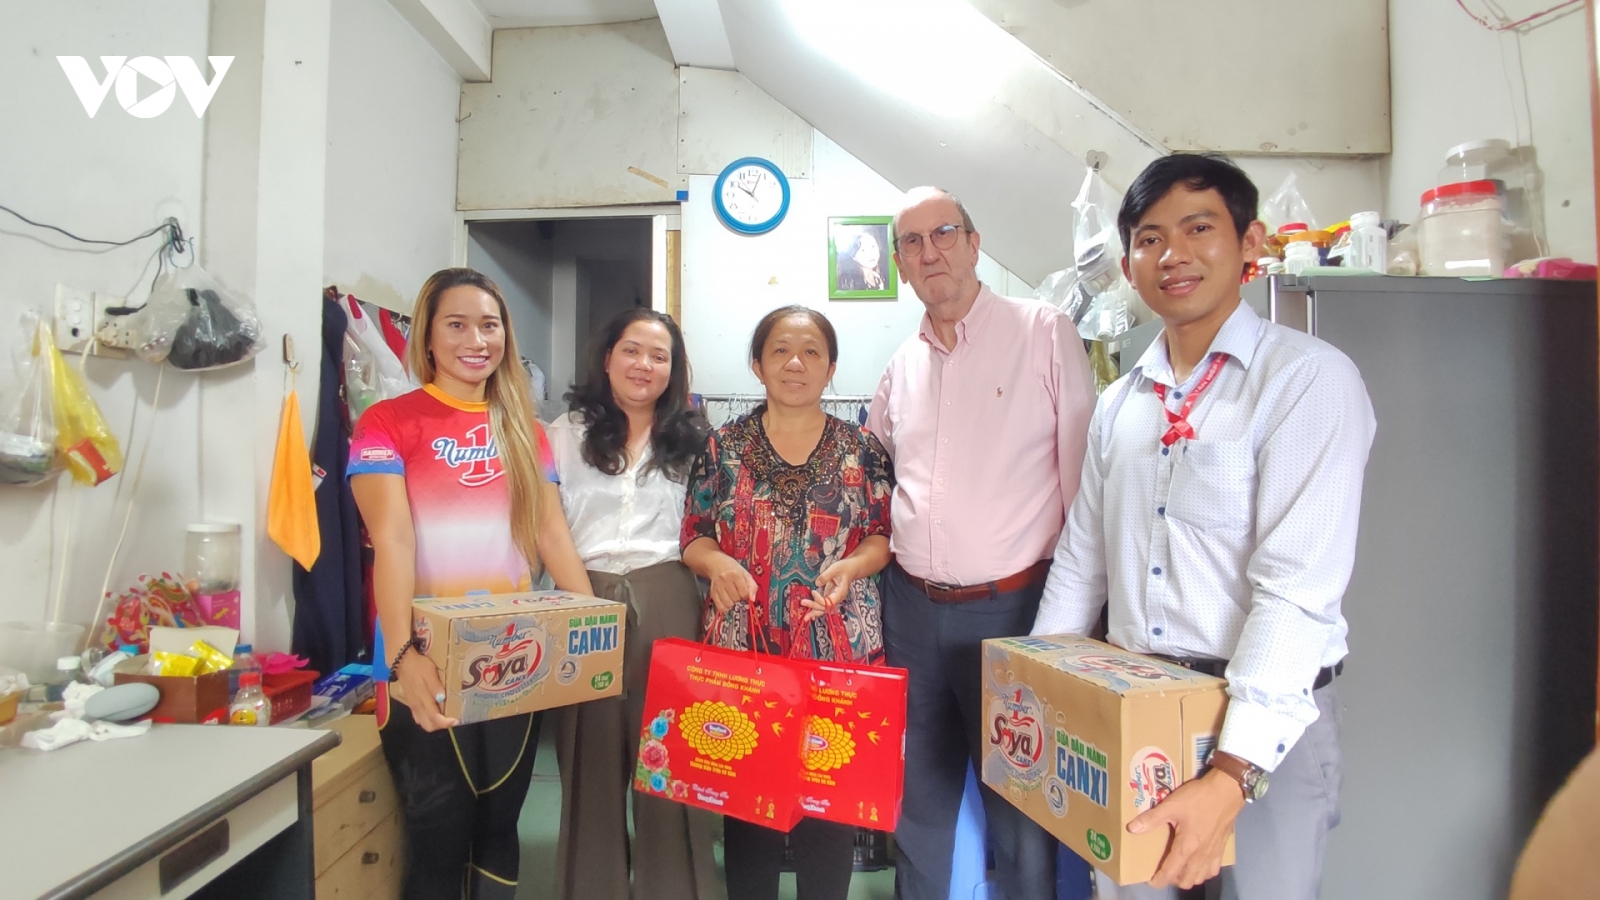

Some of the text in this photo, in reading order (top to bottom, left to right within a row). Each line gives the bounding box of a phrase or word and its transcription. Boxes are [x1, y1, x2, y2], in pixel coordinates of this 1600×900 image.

[488, 627, 530, 648] Number
[568, 624, 618, 656] CANXI
[462, 653, 529, 690] Soya
[1002, 693, 1032, 715] Number
[990, 713, 1032, 757] Soya
[1056, 745, 1108, 808] CANXI
